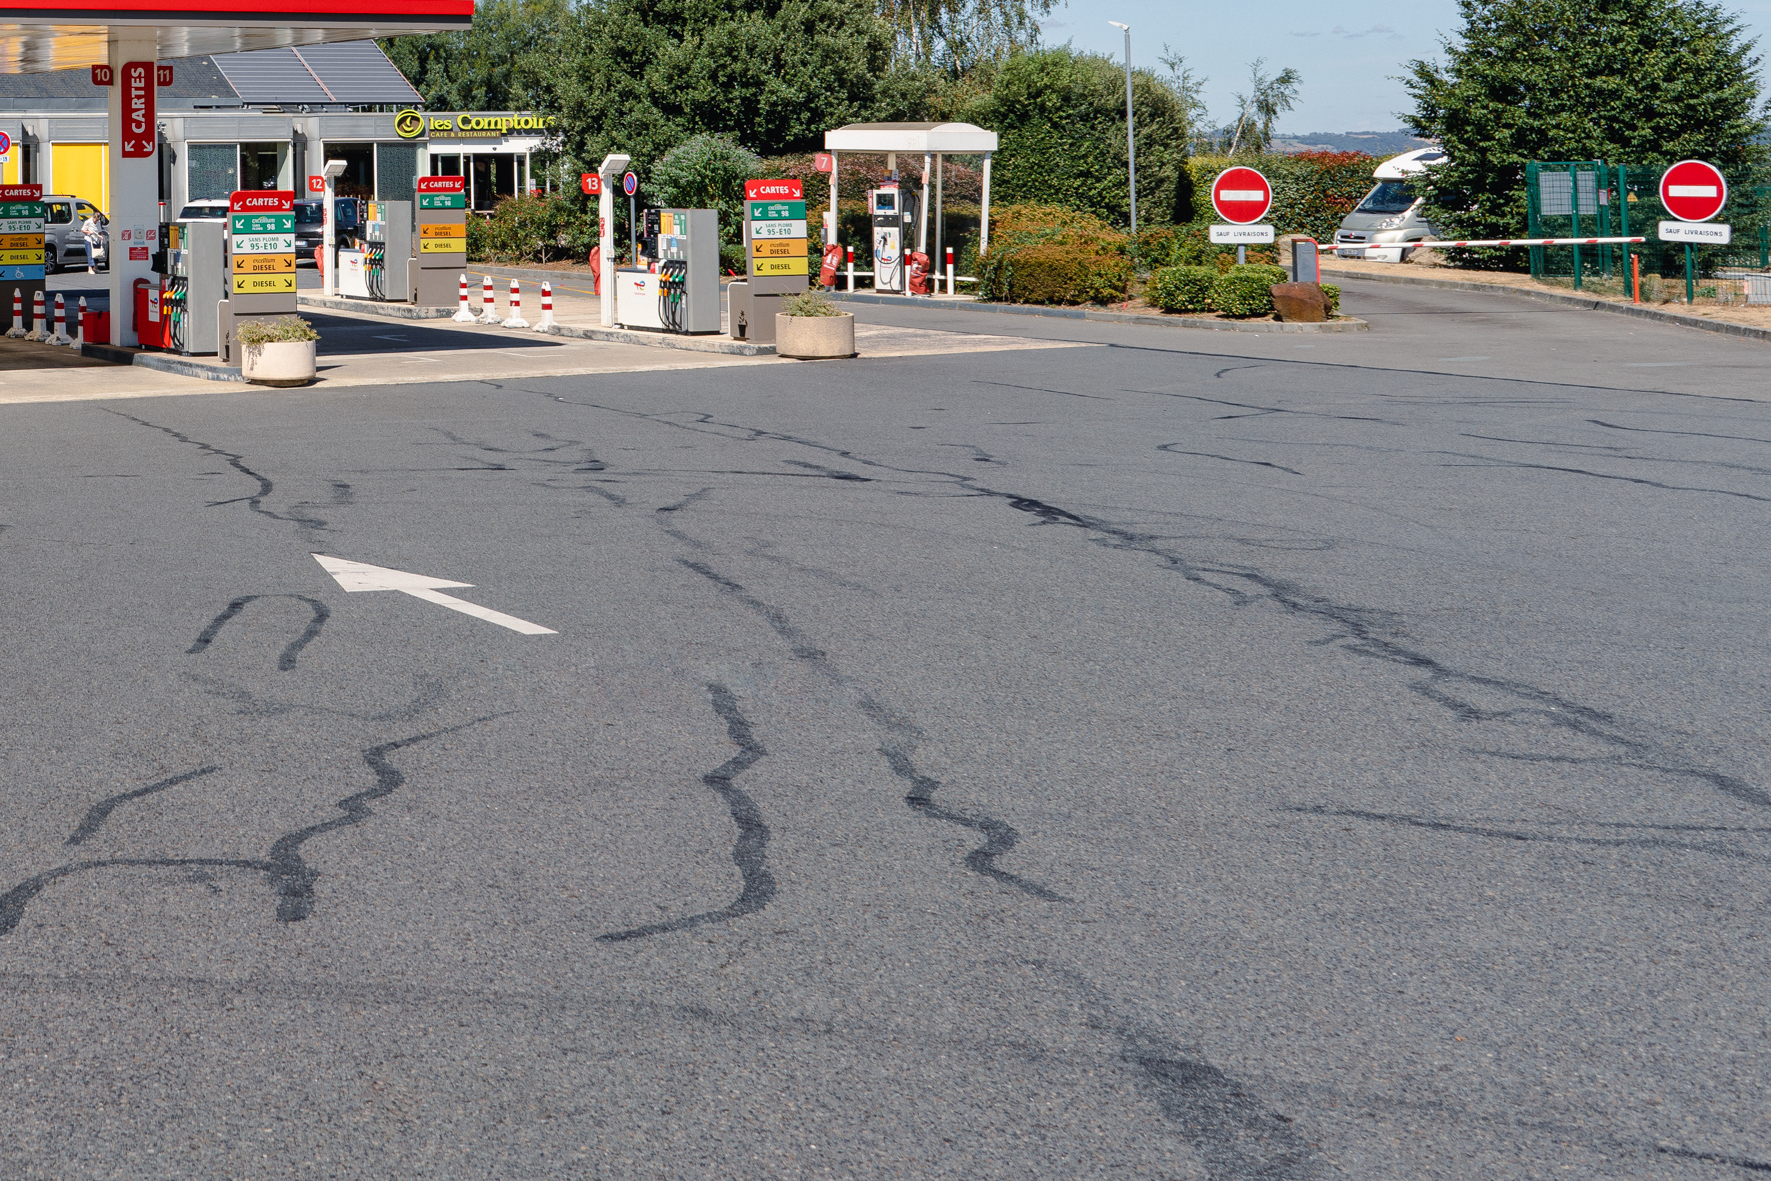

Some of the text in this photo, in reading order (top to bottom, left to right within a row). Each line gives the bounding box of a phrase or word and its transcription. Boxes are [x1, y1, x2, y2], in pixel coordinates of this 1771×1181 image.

[94, 68, 110, 82] 10
[157, 69, 170, 82] 11
[130, 67, 145, 134] CARTES
[429, 116, 452, 130] les
[820, 157, 829, 168] 7
[311, 178, 323, 189] 12
[585, 177, 599, 190] 13
[759, 185, 790, 194] CARTES
[245, 197, 279, 206] CARTES
[266, 223, 276, 231] 98
[766, 228, 792, 236] 95-E10
[1684, 229, 1723, 237] LIVRAISONS
[249, 242, 278, 251] 95-E10
